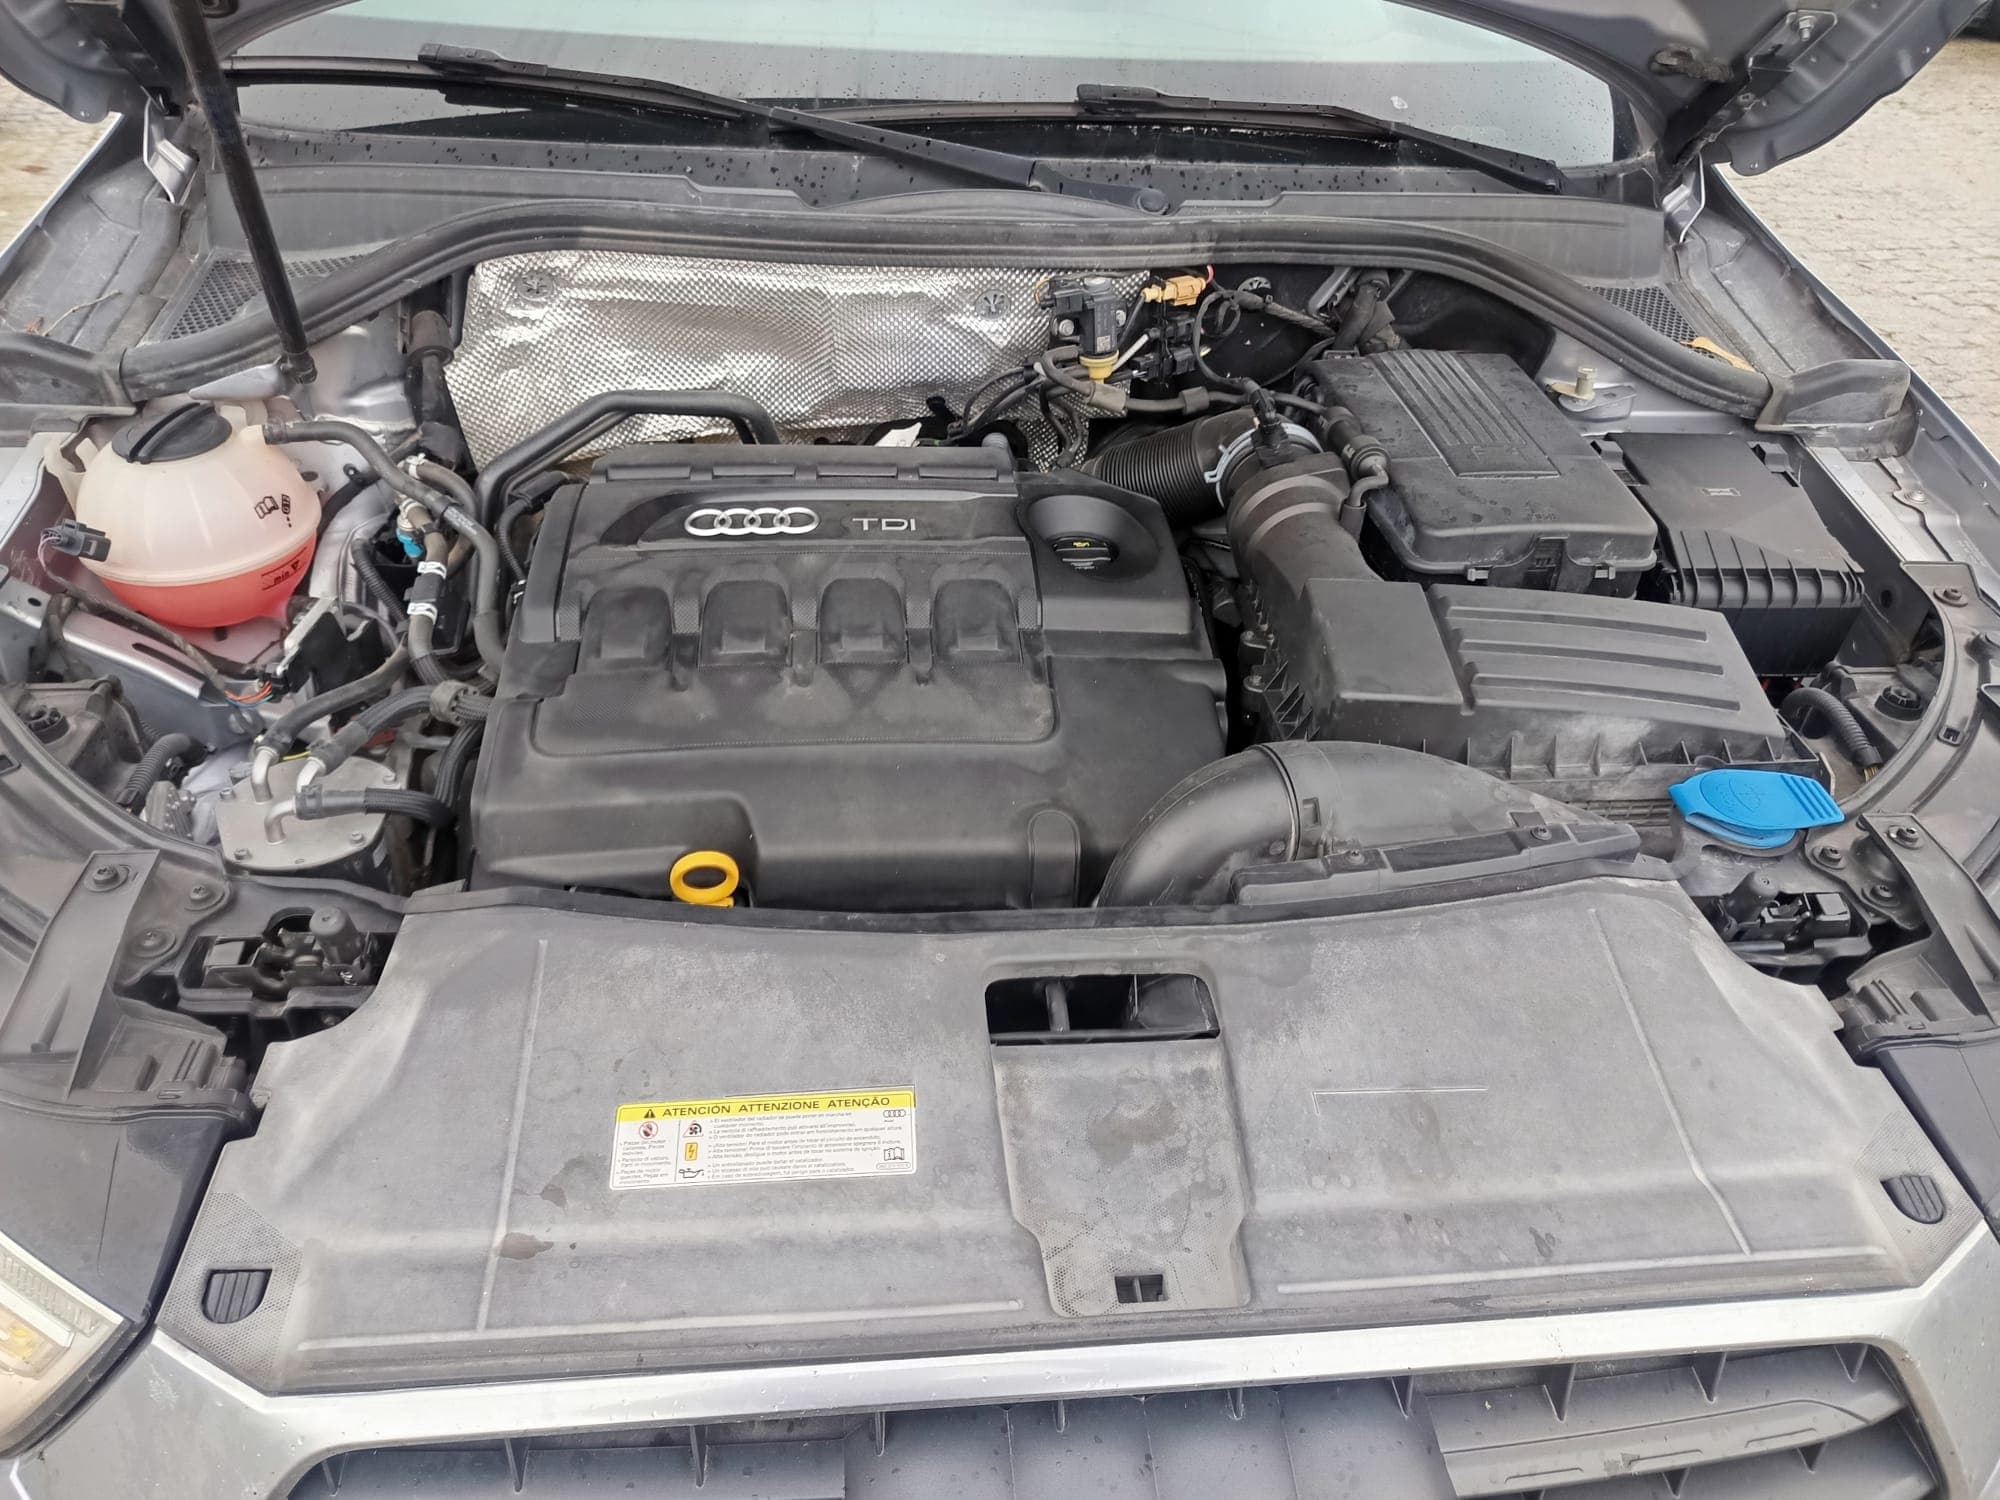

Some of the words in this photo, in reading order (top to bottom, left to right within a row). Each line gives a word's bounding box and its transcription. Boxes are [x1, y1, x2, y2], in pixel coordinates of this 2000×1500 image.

[852, 518, 916, 531] TDI
[274, 570, 290, 584] min
[662, 1104, 731, 1117] ATENCIÓN
[738, 1100, 820, 1113] ATTENZIONE
[827, 1096, 890, 1108] ATENÇÃO
